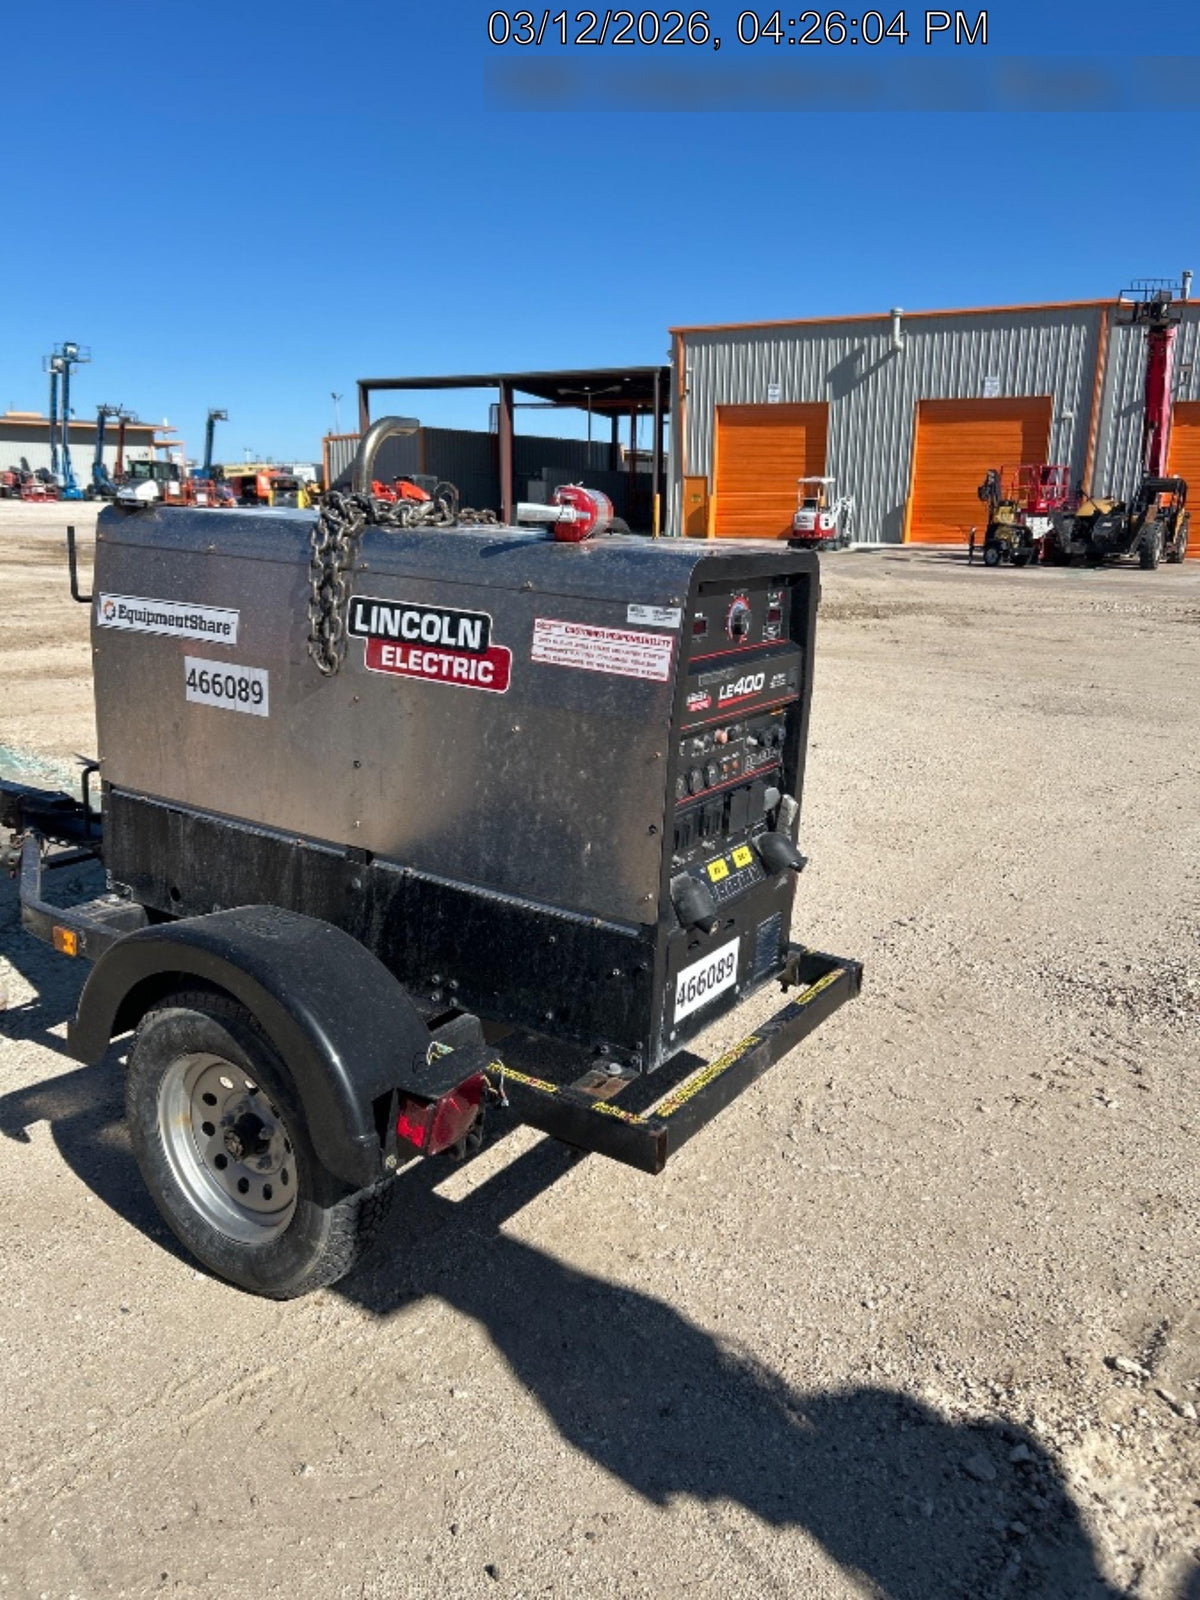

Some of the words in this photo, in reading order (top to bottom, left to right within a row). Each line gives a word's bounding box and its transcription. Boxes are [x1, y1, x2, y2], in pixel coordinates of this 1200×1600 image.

[117, 604, 231, 637] EquipmentShare
[354, 603, 483, 650] LINCOLN
[380, 645, 494, 684] ELECTRIC
[185, 668, 264, 706] 466089
[718, 671, 766, 700] LE400
[676, 952, 735, 1007] 466089
